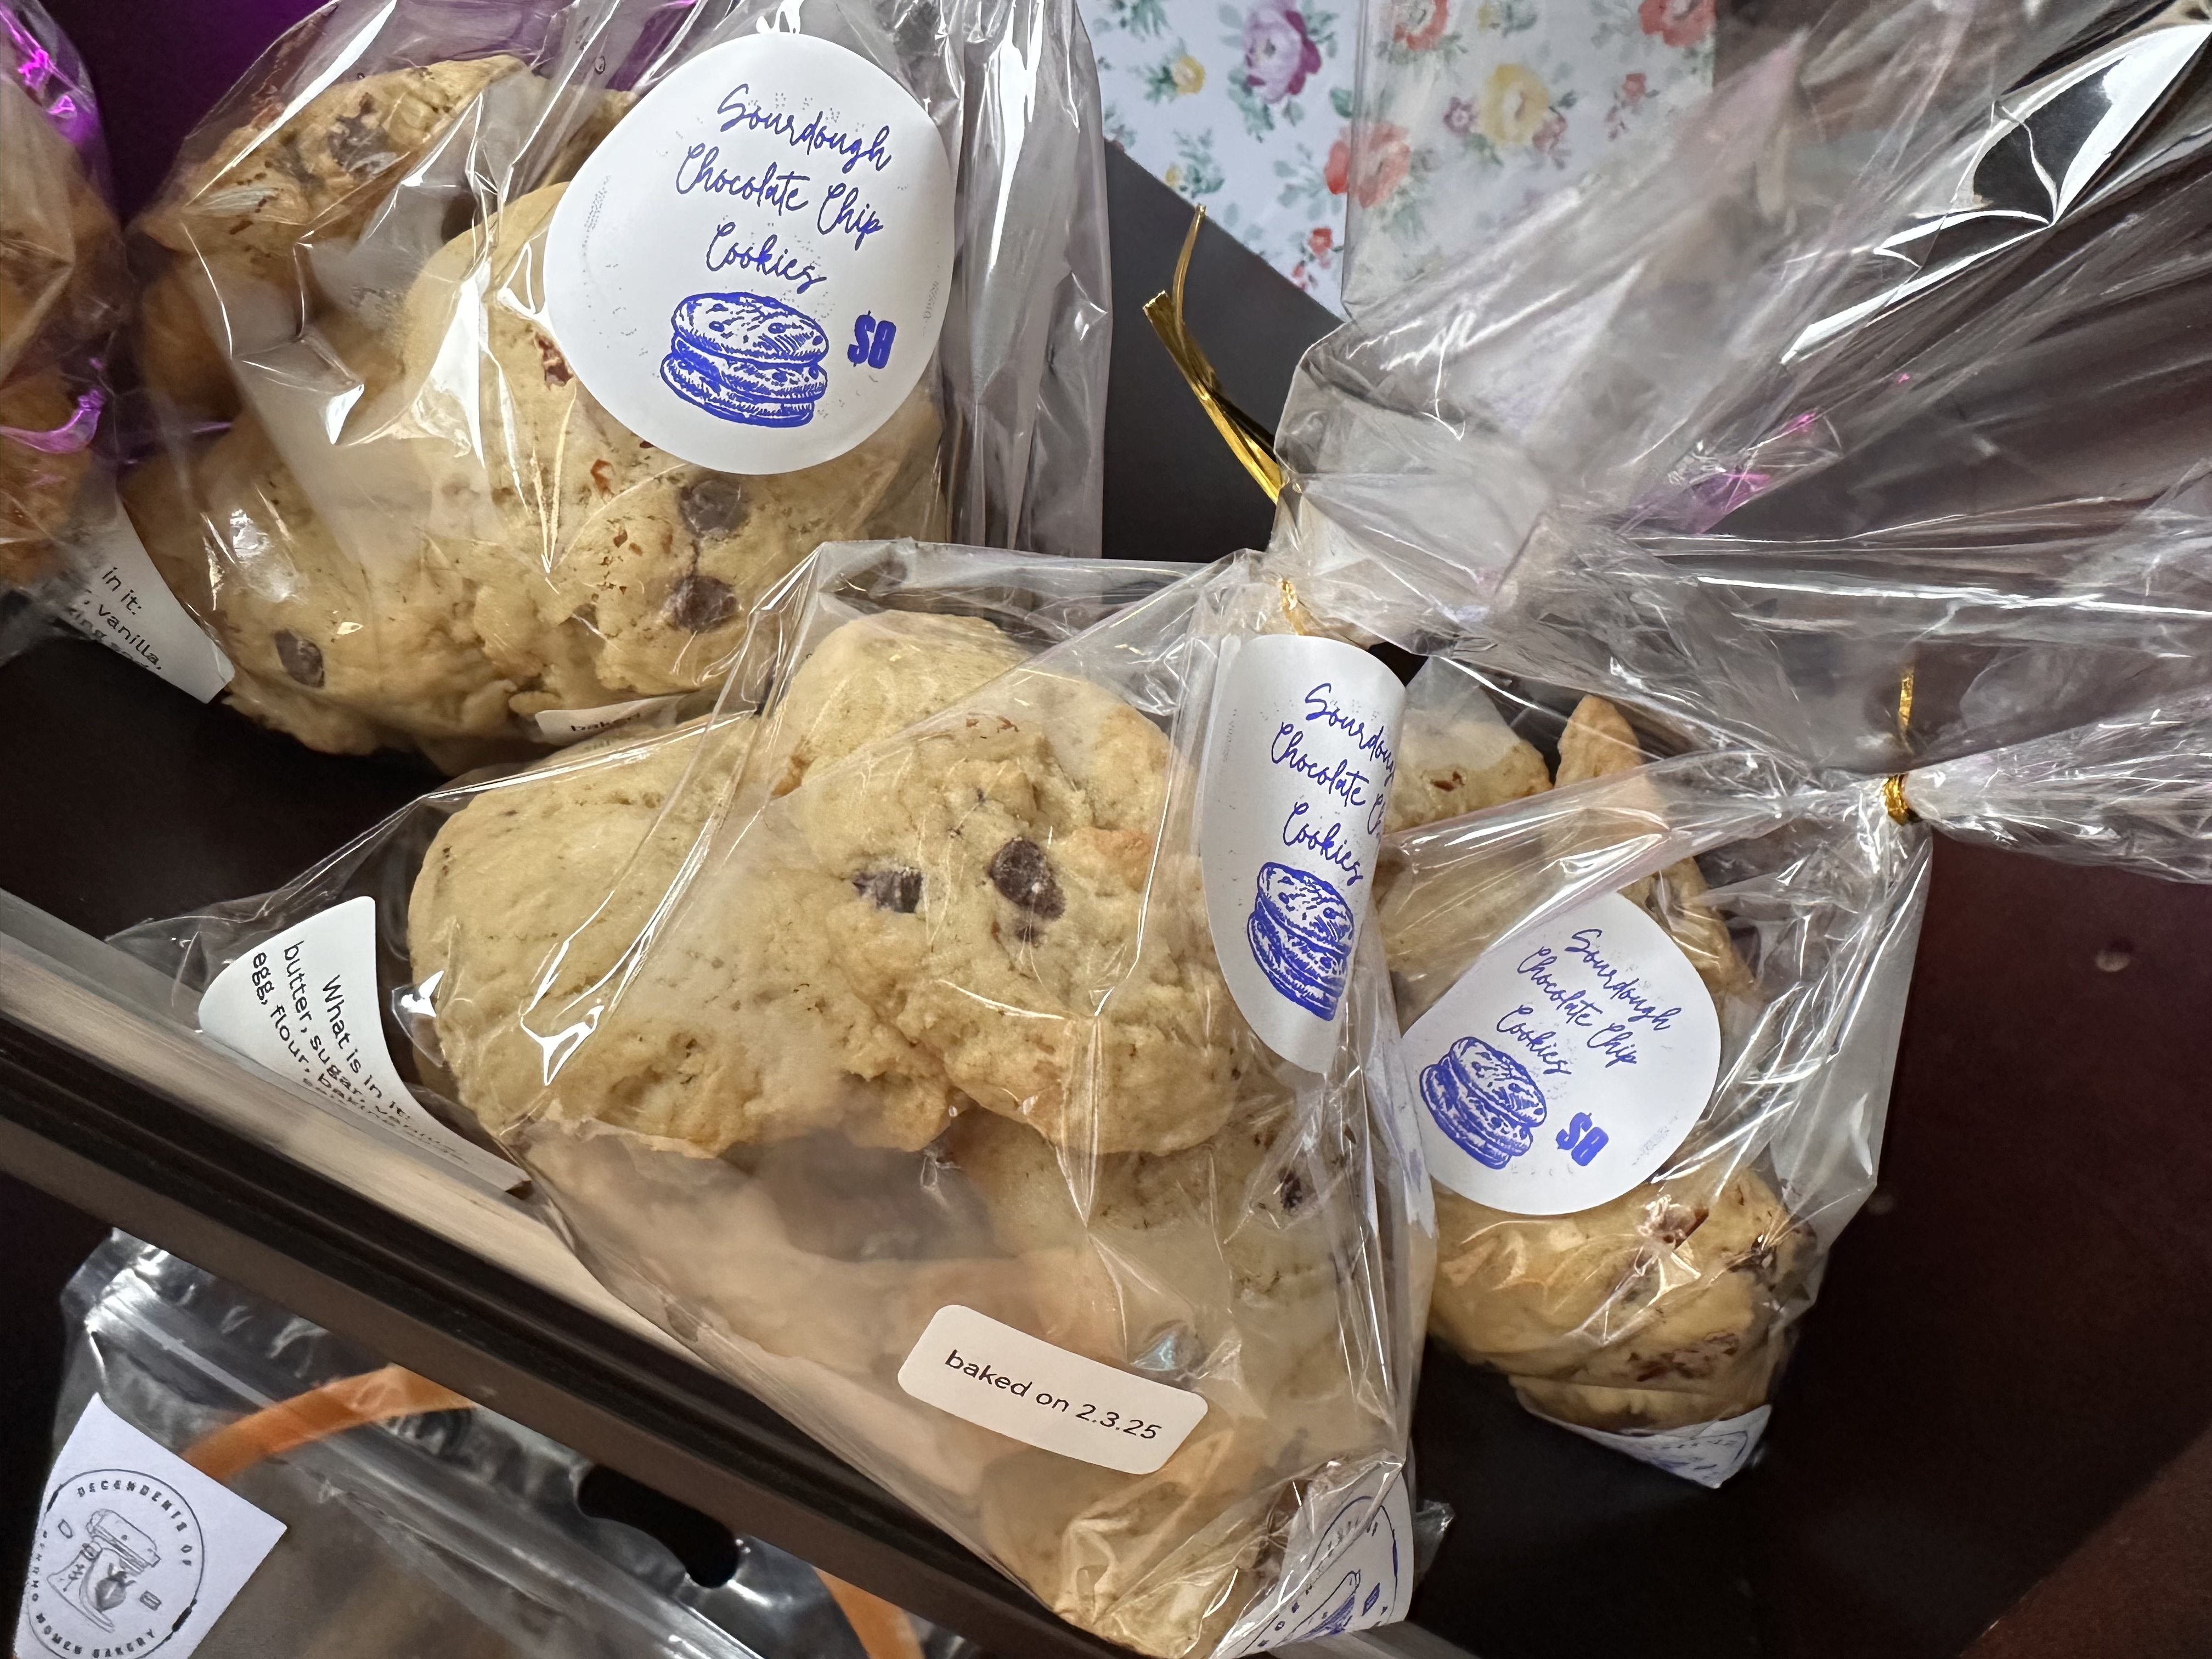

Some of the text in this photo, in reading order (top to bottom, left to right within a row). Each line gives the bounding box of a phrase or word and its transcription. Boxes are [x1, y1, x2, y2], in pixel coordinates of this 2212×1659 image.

[716, 83, 891, 173] Sourdough
[676, 143, 884, 250] Chocolate Chip
[706, 223, 827, 294] Cookies
[847, 310, 897, 369] $8
[101, 567, 142, 615] in it:
[98, 604, 162, 670] vanilla,
[1271, 721, 1369, 807] Chocolate
[1305, 683, 1395, 787] Sourdoug
[1283, 802, 1363, 886] Cookies
[252, 951, 275, 1006] egg,
[270, 1005, 311, 1073] flour,
[284, 940, 312, 1034] butter,
[309, 1035, 366, 1104] sugar,
[1516, 946, 1637, 1068] Chocolate Chip
[1565, 928, 1682, 1031] Sourdough
[323, 974, 352, 1050] What
[346, 1047, 362, 1074] is
[365, 1076, 383, 1099] in
[1496, 1005, 1572, 1075] Cookies
[1556, 1111, 1609, 1167] $8
[945, 1349, 1162, 1440] baked on 2.3.25
